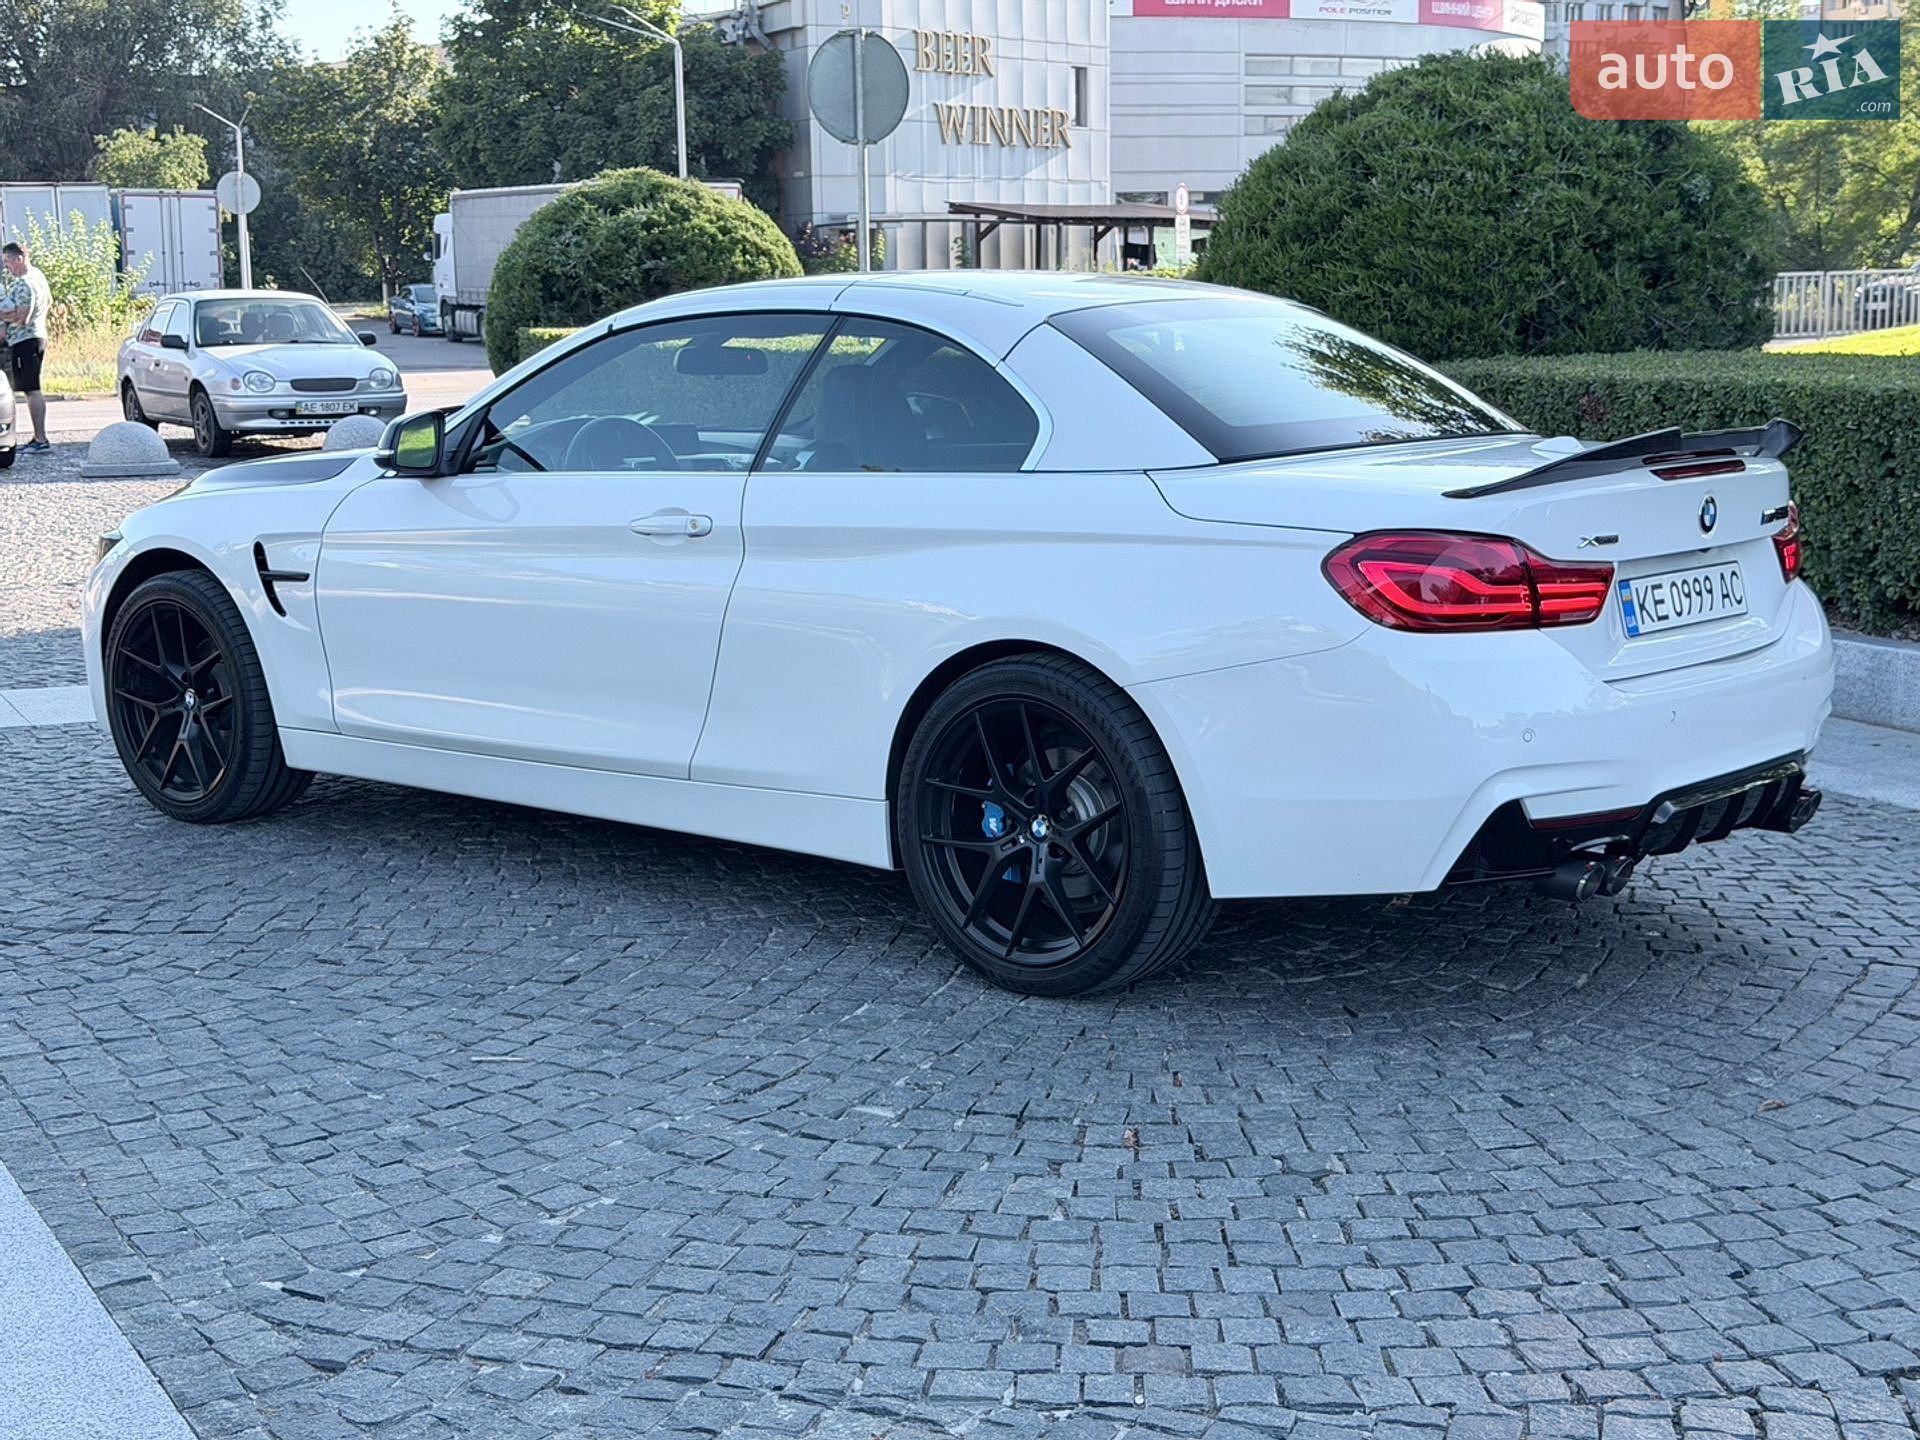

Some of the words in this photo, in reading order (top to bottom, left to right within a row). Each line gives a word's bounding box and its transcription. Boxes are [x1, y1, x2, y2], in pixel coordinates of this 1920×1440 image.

[913, 30, 995, 77] BEER
[933, 103, 1072, 149] WINNER
[1635, 583, 1669, 625] KE
[1669, 575, 1713, 618] 0999
[1719, 570, 1743, 609] AC
